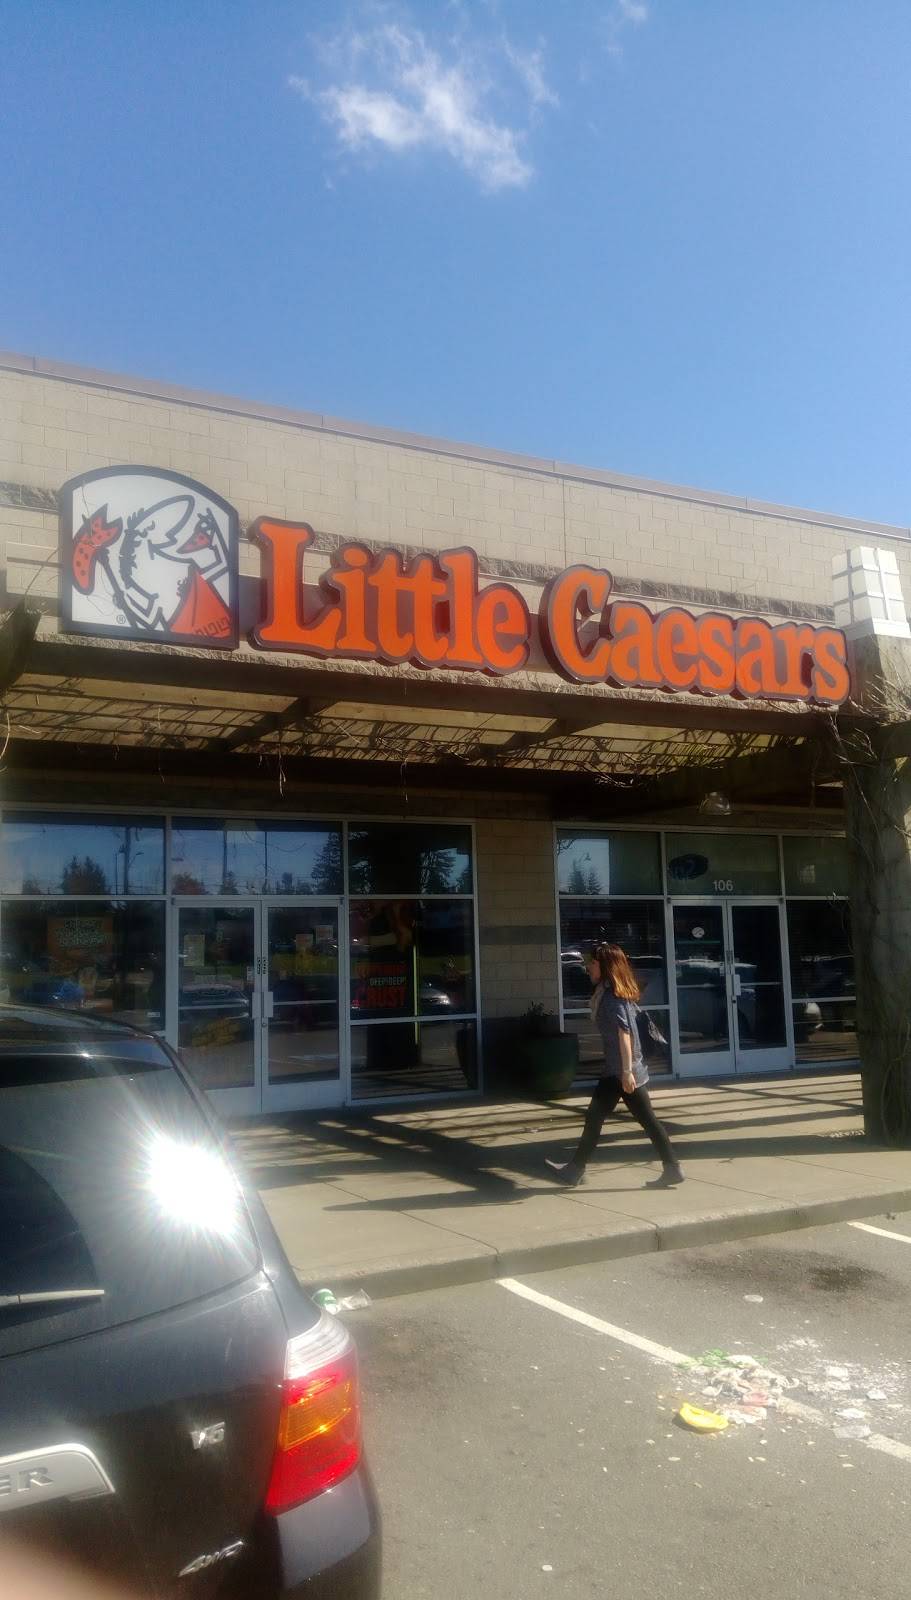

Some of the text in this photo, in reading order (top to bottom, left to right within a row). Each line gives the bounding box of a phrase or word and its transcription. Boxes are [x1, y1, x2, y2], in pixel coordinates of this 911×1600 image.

[256, 518, 849, 703] Little Caesars
[712, 879, 734, 892] 106
[190, 1421, 225, 1450] V6
